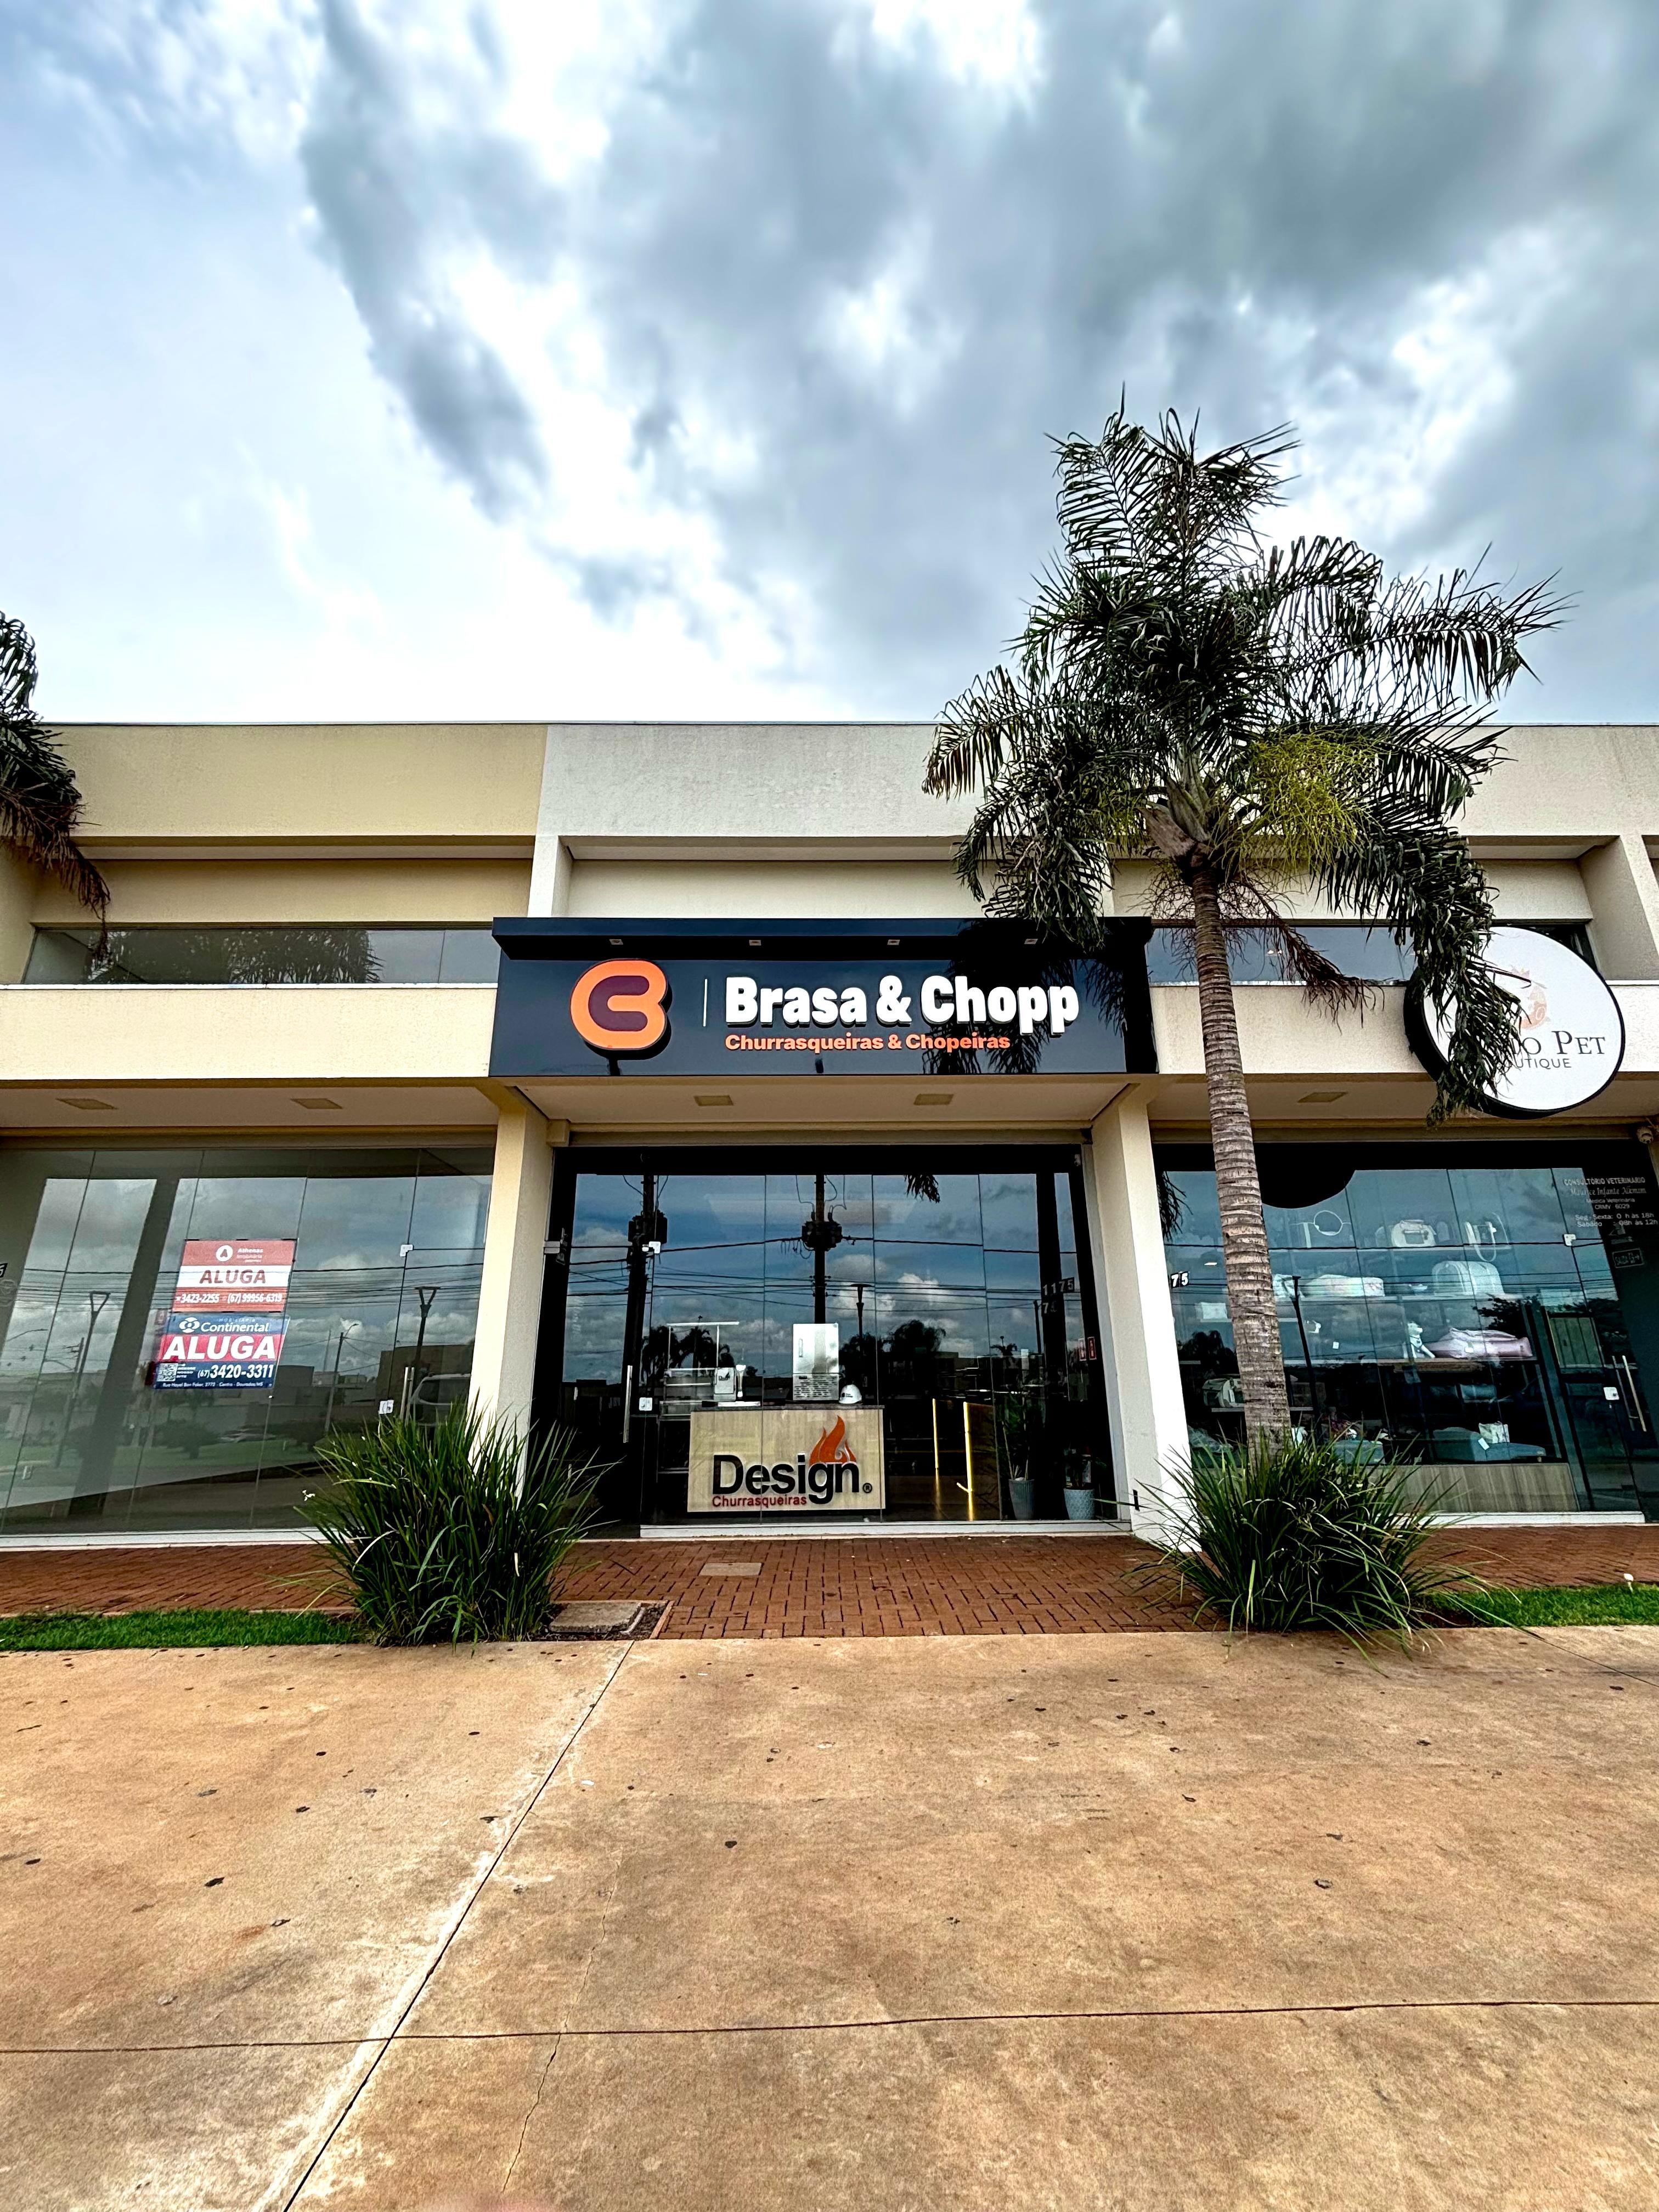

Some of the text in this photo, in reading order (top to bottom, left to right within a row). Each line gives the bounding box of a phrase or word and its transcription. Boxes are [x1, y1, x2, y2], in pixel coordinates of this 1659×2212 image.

[726, 975, 1080, 1035] Brasa & Chopp
[725, 1032, 1011, 1053] Churrasqueiras & Chopeiras
[199, 1269, 266, 1284] ALUGA
[201, 1322, 269, 1333] Continental
[162, 1335, 276, 1360] ALUGA
[713, 1454, 860, 1505] Design
[712, 1494, 808, 1509] Churrasqueiras
